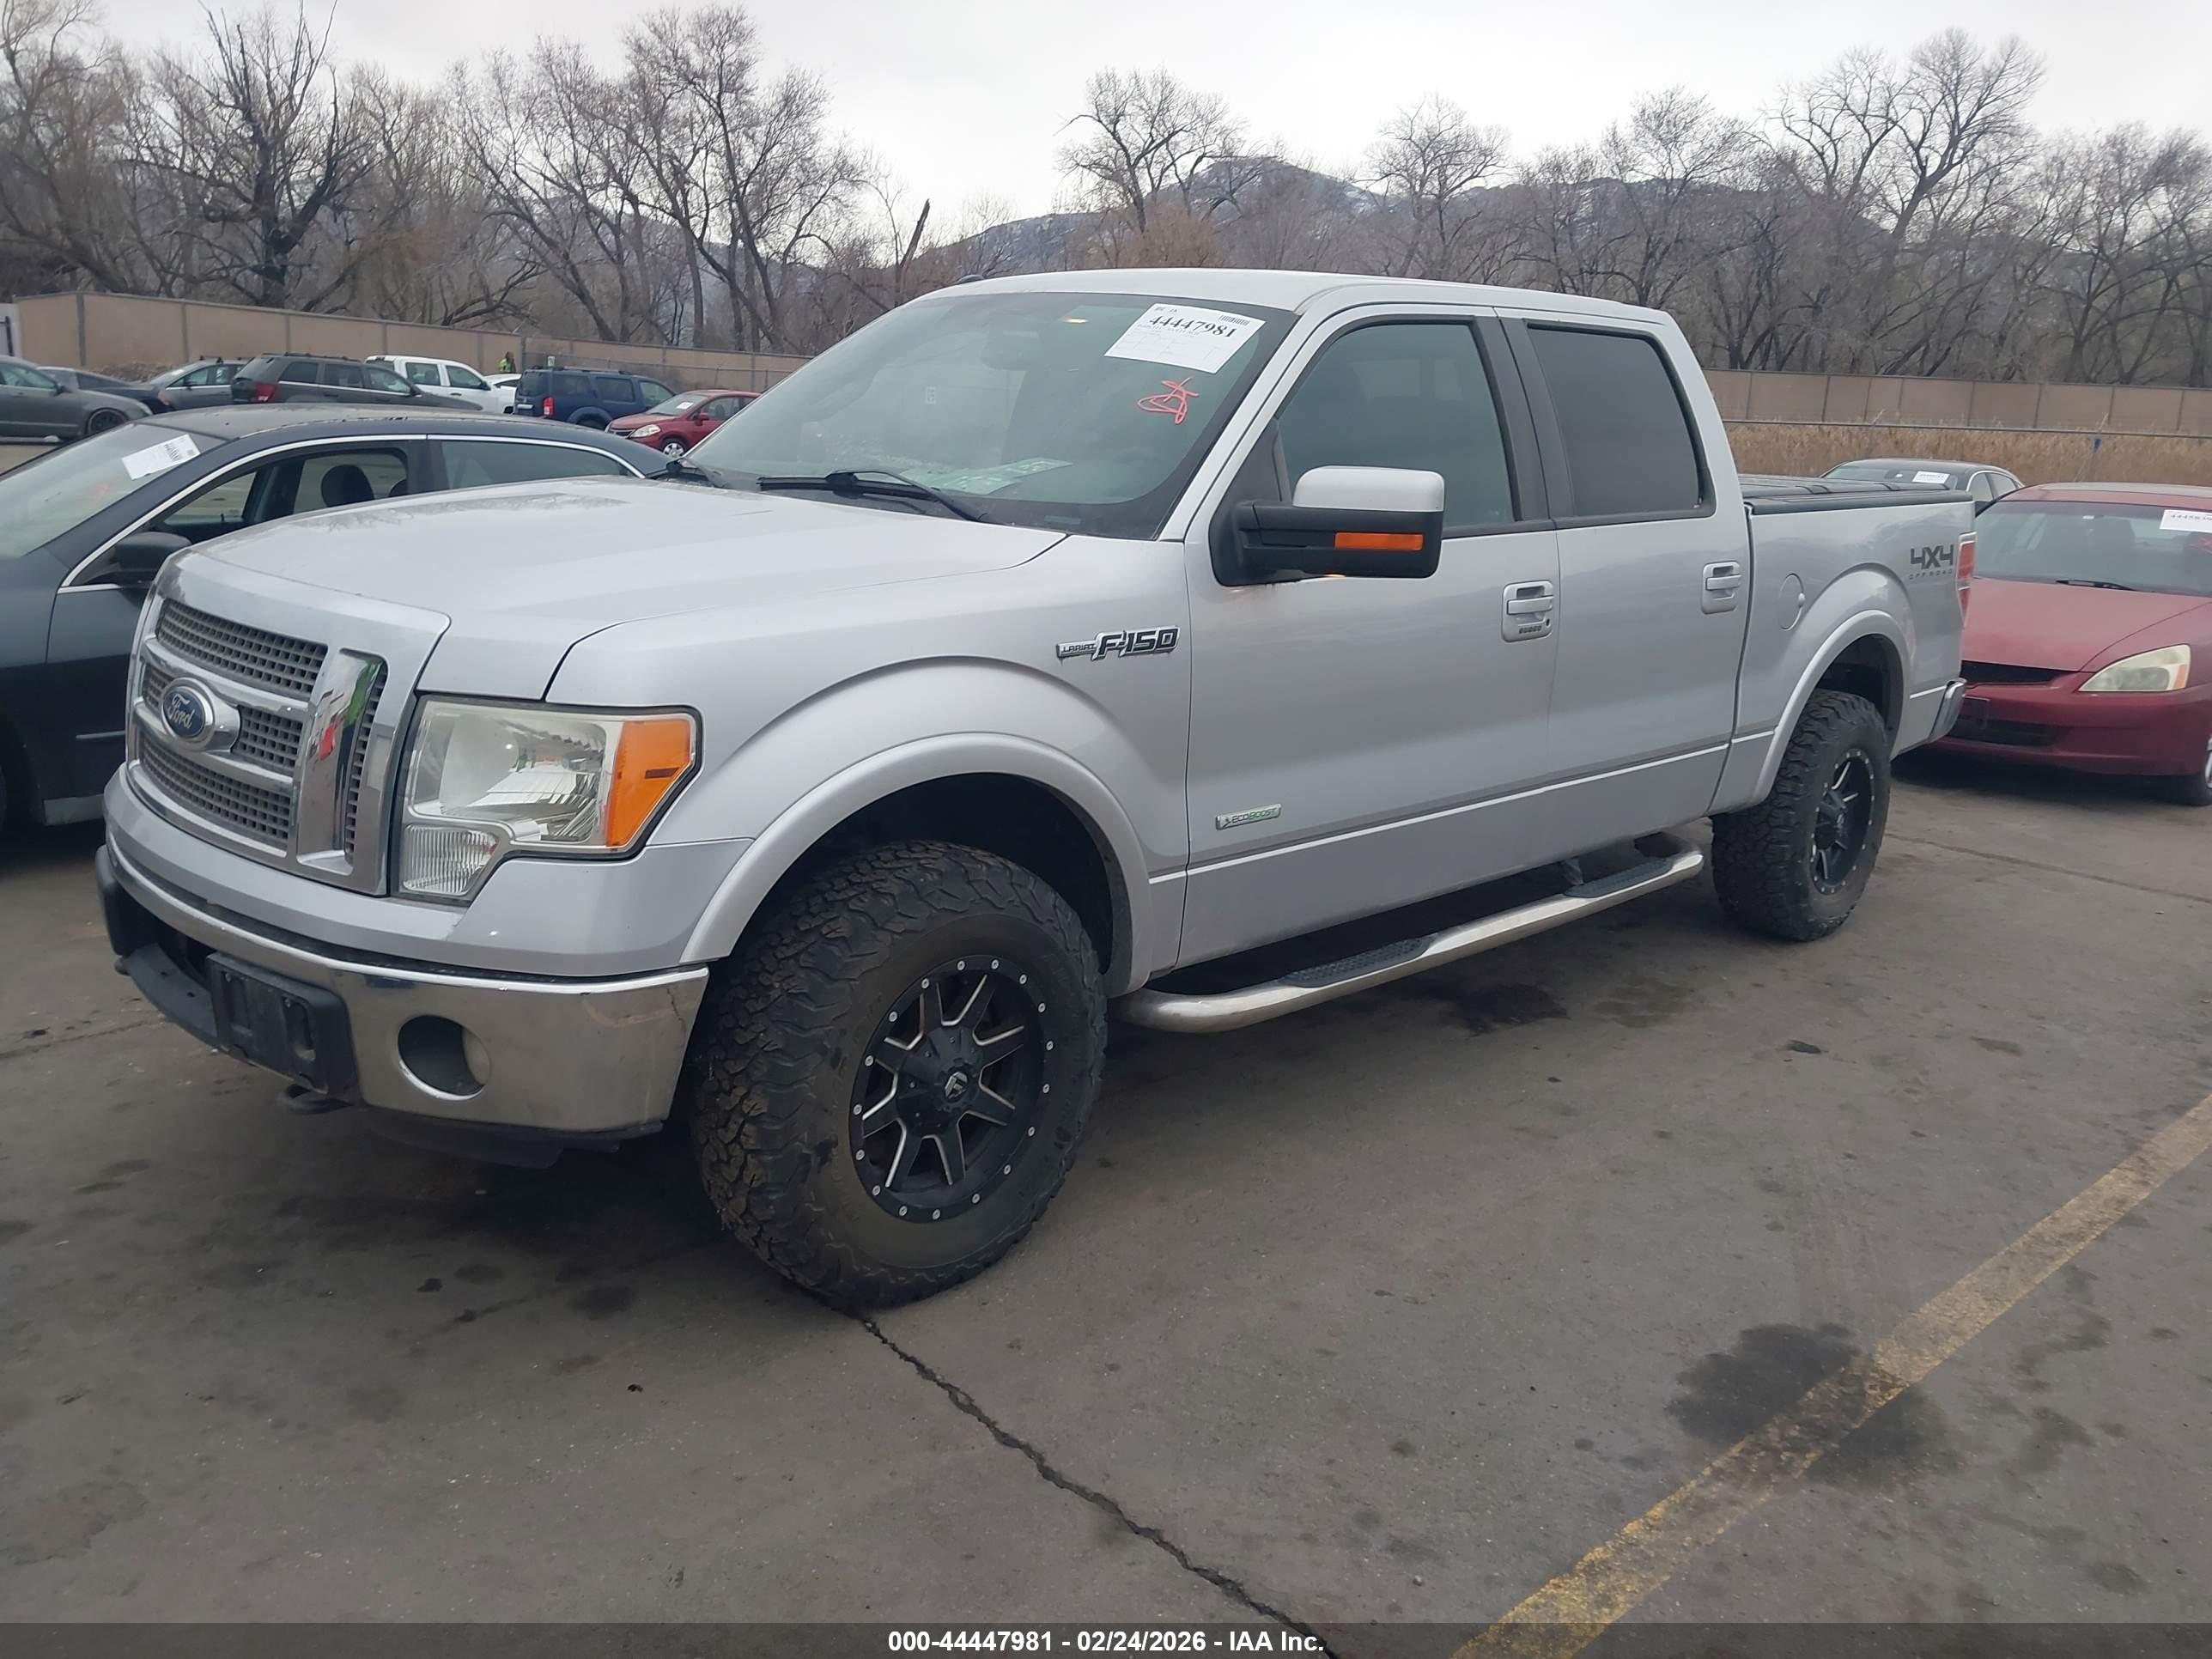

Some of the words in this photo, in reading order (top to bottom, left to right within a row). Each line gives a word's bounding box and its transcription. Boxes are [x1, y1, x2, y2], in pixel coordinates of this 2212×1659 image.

[1148, 315, 1238, 337] 44447981
[1093, 627, 1180, 659] F-150
[167, 693, 196, 729] Ford
